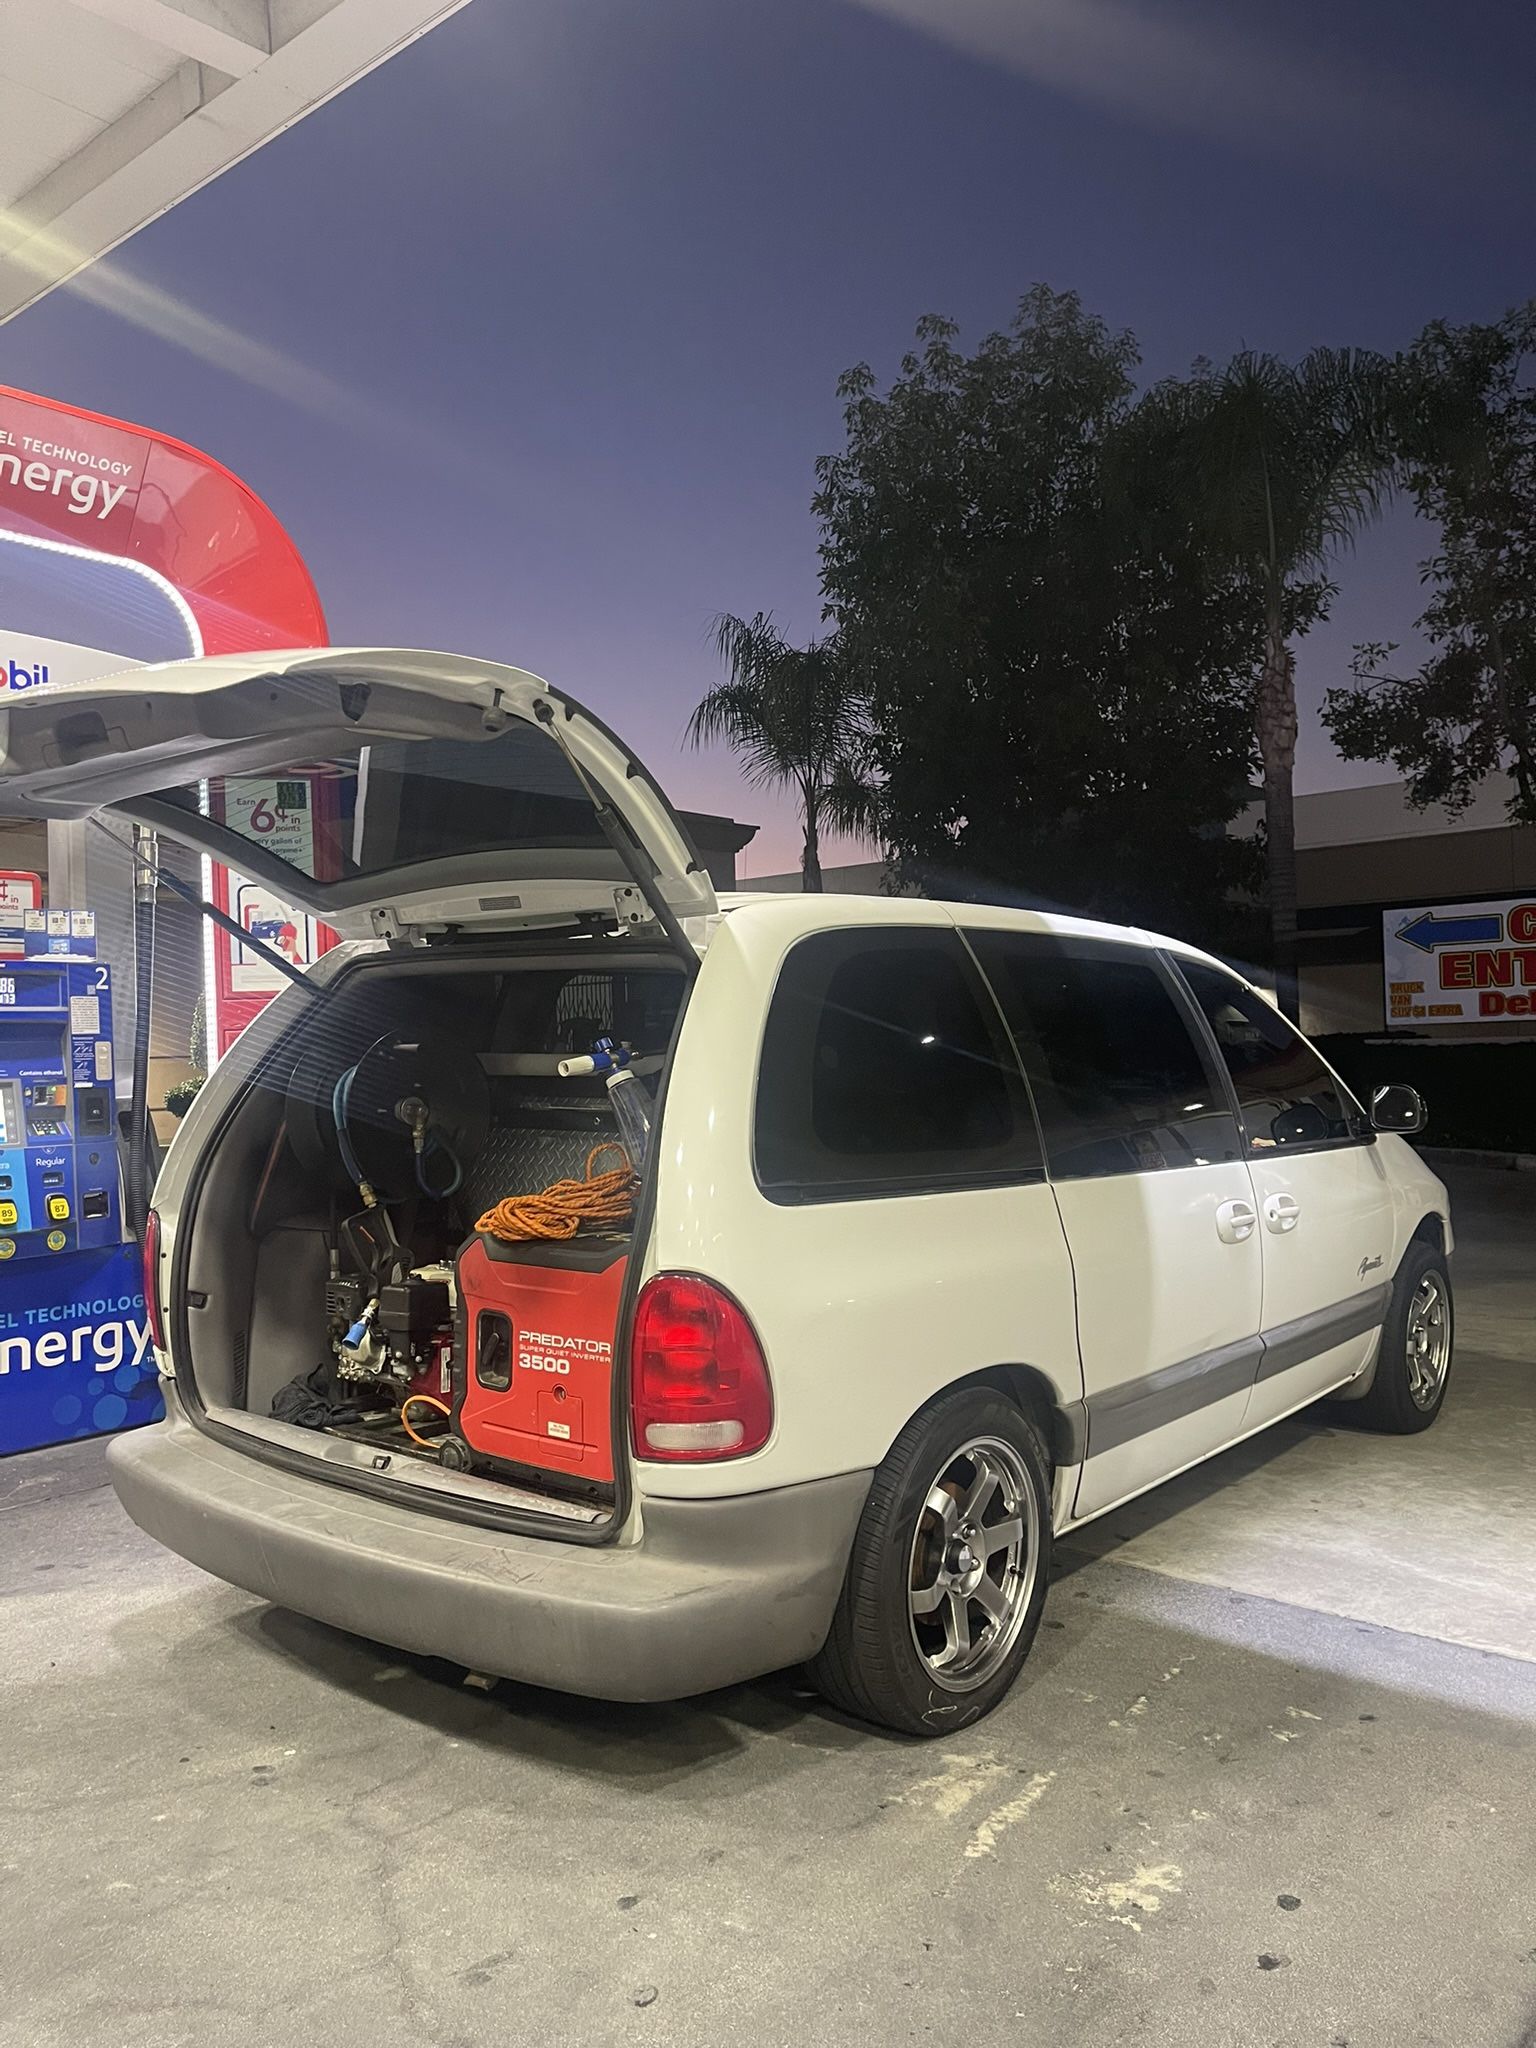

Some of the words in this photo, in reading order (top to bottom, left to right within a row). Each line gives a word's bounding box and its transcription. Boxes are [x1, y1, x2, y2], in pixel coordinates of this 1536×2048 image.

[22, 436, 132, 476] TECHNOLOGY
[236, 798, 256, 806] Earn
[291, 815, 301, 824] in
[275, 823, 301, 833] points
[270, 837, 293, 846] gallon
[10, 896, 19, 904] in
[95, 967, 109, 990] 2
[1480, 990, 1536, 1016] De
[36, 1157, 65, 1168] Regular
[2, 1209, 13, 1218] 89
[55, 1205, 65, 1213] 87
[519, 1331, 611, 1354] PREDATOR
[520, 1344, 545, 1353] SUPER
[546, 1349, 569, 1357] QUIET
[571, 1353, 611, 1363] INVERTER
[519, 1353, 570, 1375] 3500
